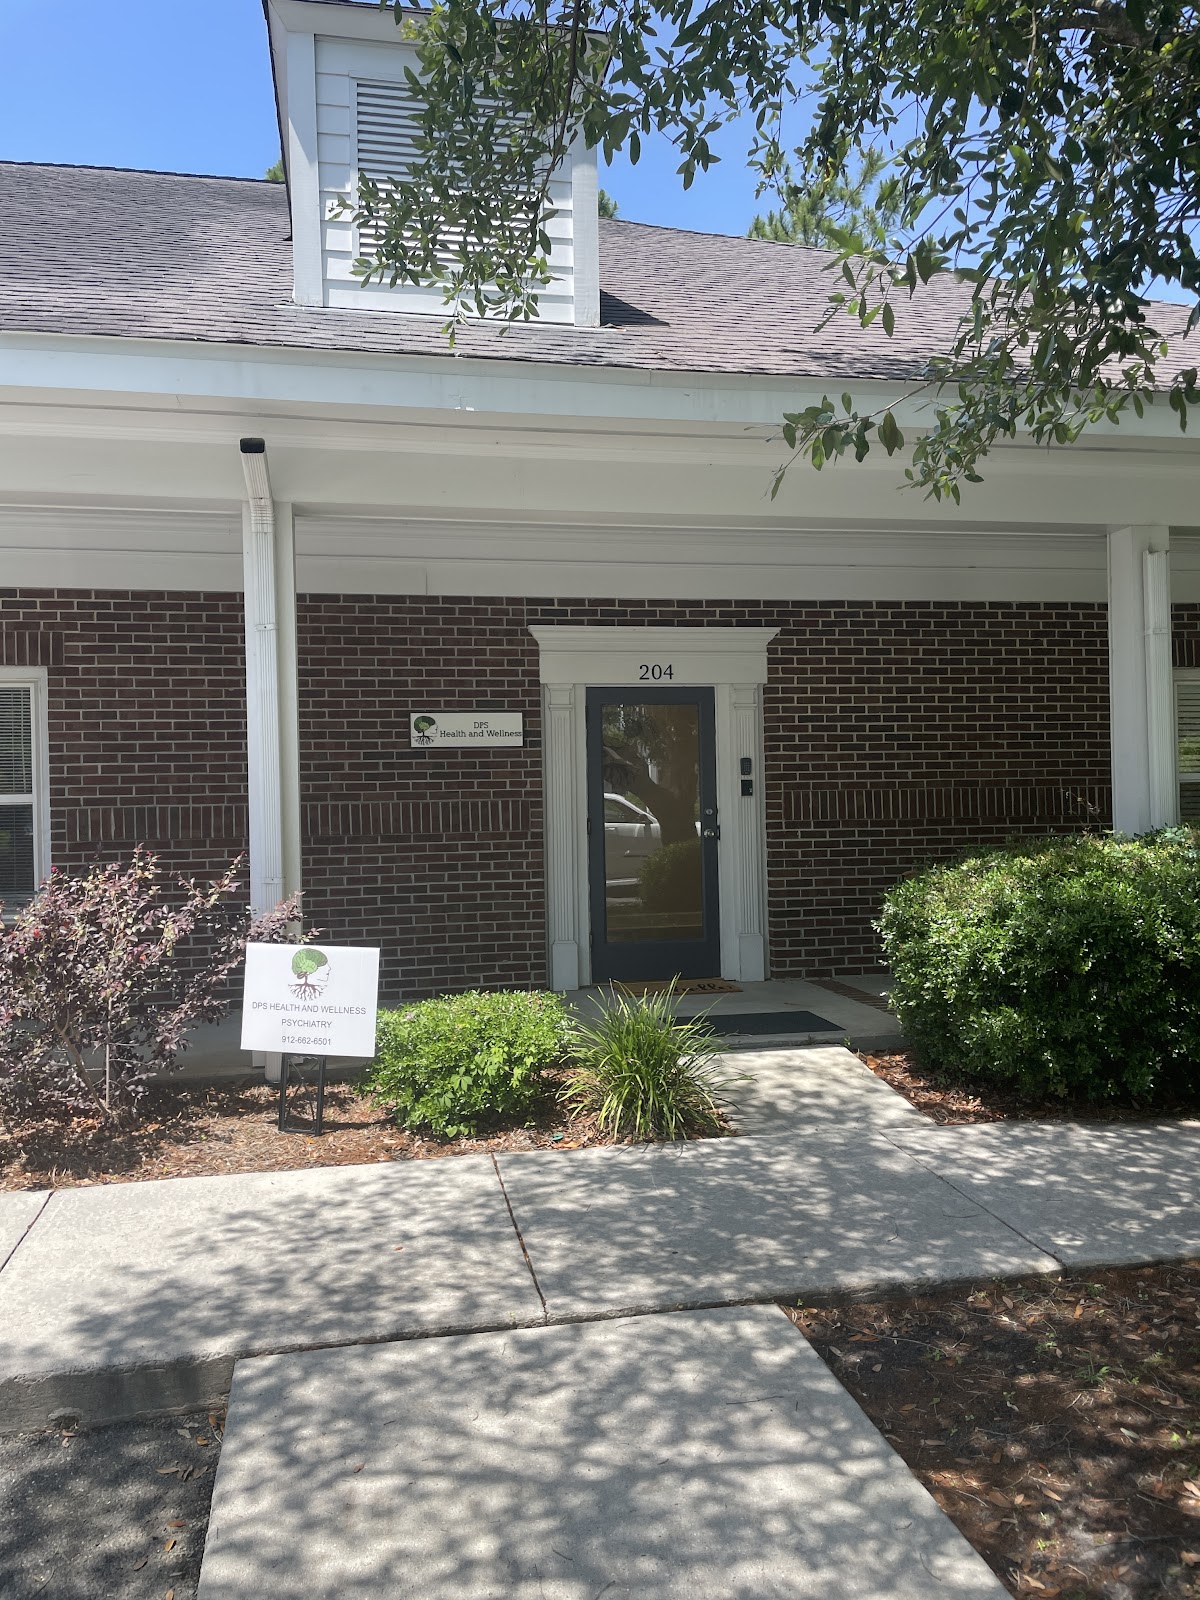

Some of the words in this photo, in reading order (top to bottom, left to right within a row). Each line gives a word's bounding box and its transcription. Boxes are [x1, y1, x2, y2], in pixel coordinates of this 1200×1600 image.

[639, 664, 674, 680] 204
[473, 721, 489, 729] DPS
[439, 730, 467, 738] Health
[468, 730, 484, 738] and
[486, 729, 522, 738] Wellness
[252, 1001, 268, 1010] DPS
[269, 1002, 300, 1012] HEALTH
[301, 1005, 319, 1013] AND
[320, 1006, 367, 1015] WELLNESS
[281, 1018, 333, 1029] PSYCHIATRY
[281, 1035, 331, 1046] 912-662-6501
